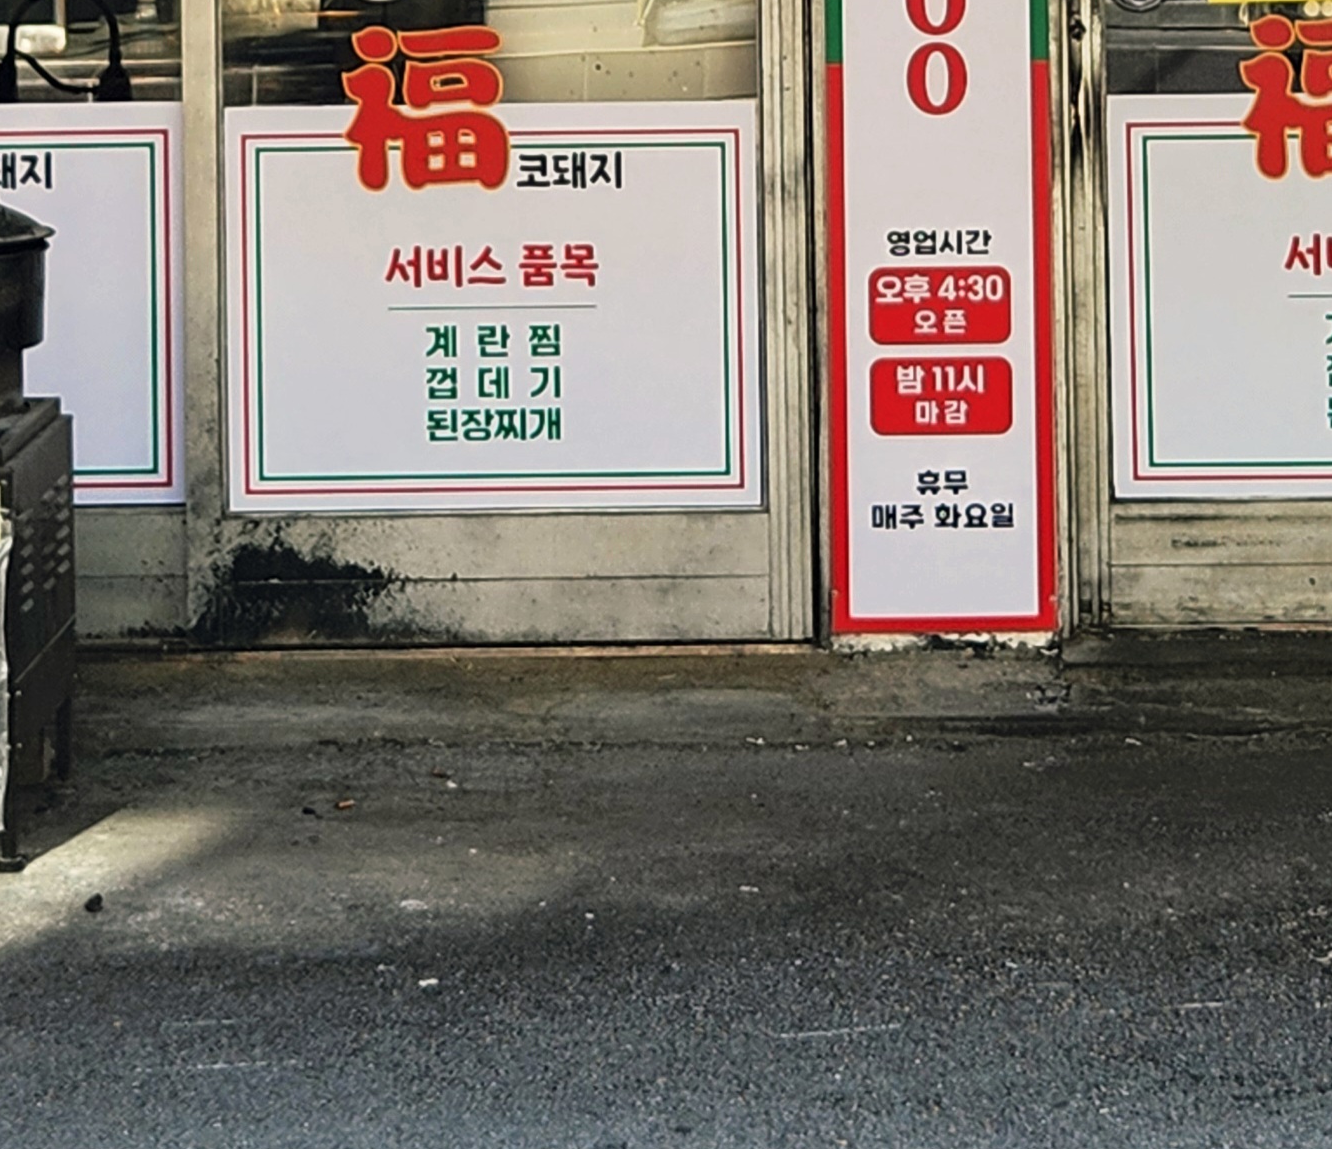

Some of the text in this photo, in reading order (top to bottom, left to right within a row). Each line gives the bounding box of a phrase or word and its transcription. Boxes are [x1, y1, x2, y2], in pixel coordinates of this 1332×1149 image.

[342, 26, 623, 191] 福 코돼지
[886, 229, 992, 256] 영업시간
[385, 244, 599, 288] 서비스 품목
[875, 274, 1004, 304] 오후 4:30
[914, 309, 967, 335] 오픈
[896, 365, 985, 394] 밤 11시
[425, 407, 562, 442] 된장찌개
[915, 399, 969, 425] 마감
[916, 469, 968, 495] 휴무
[871, 502, 1014, 530] 매주 화요일
